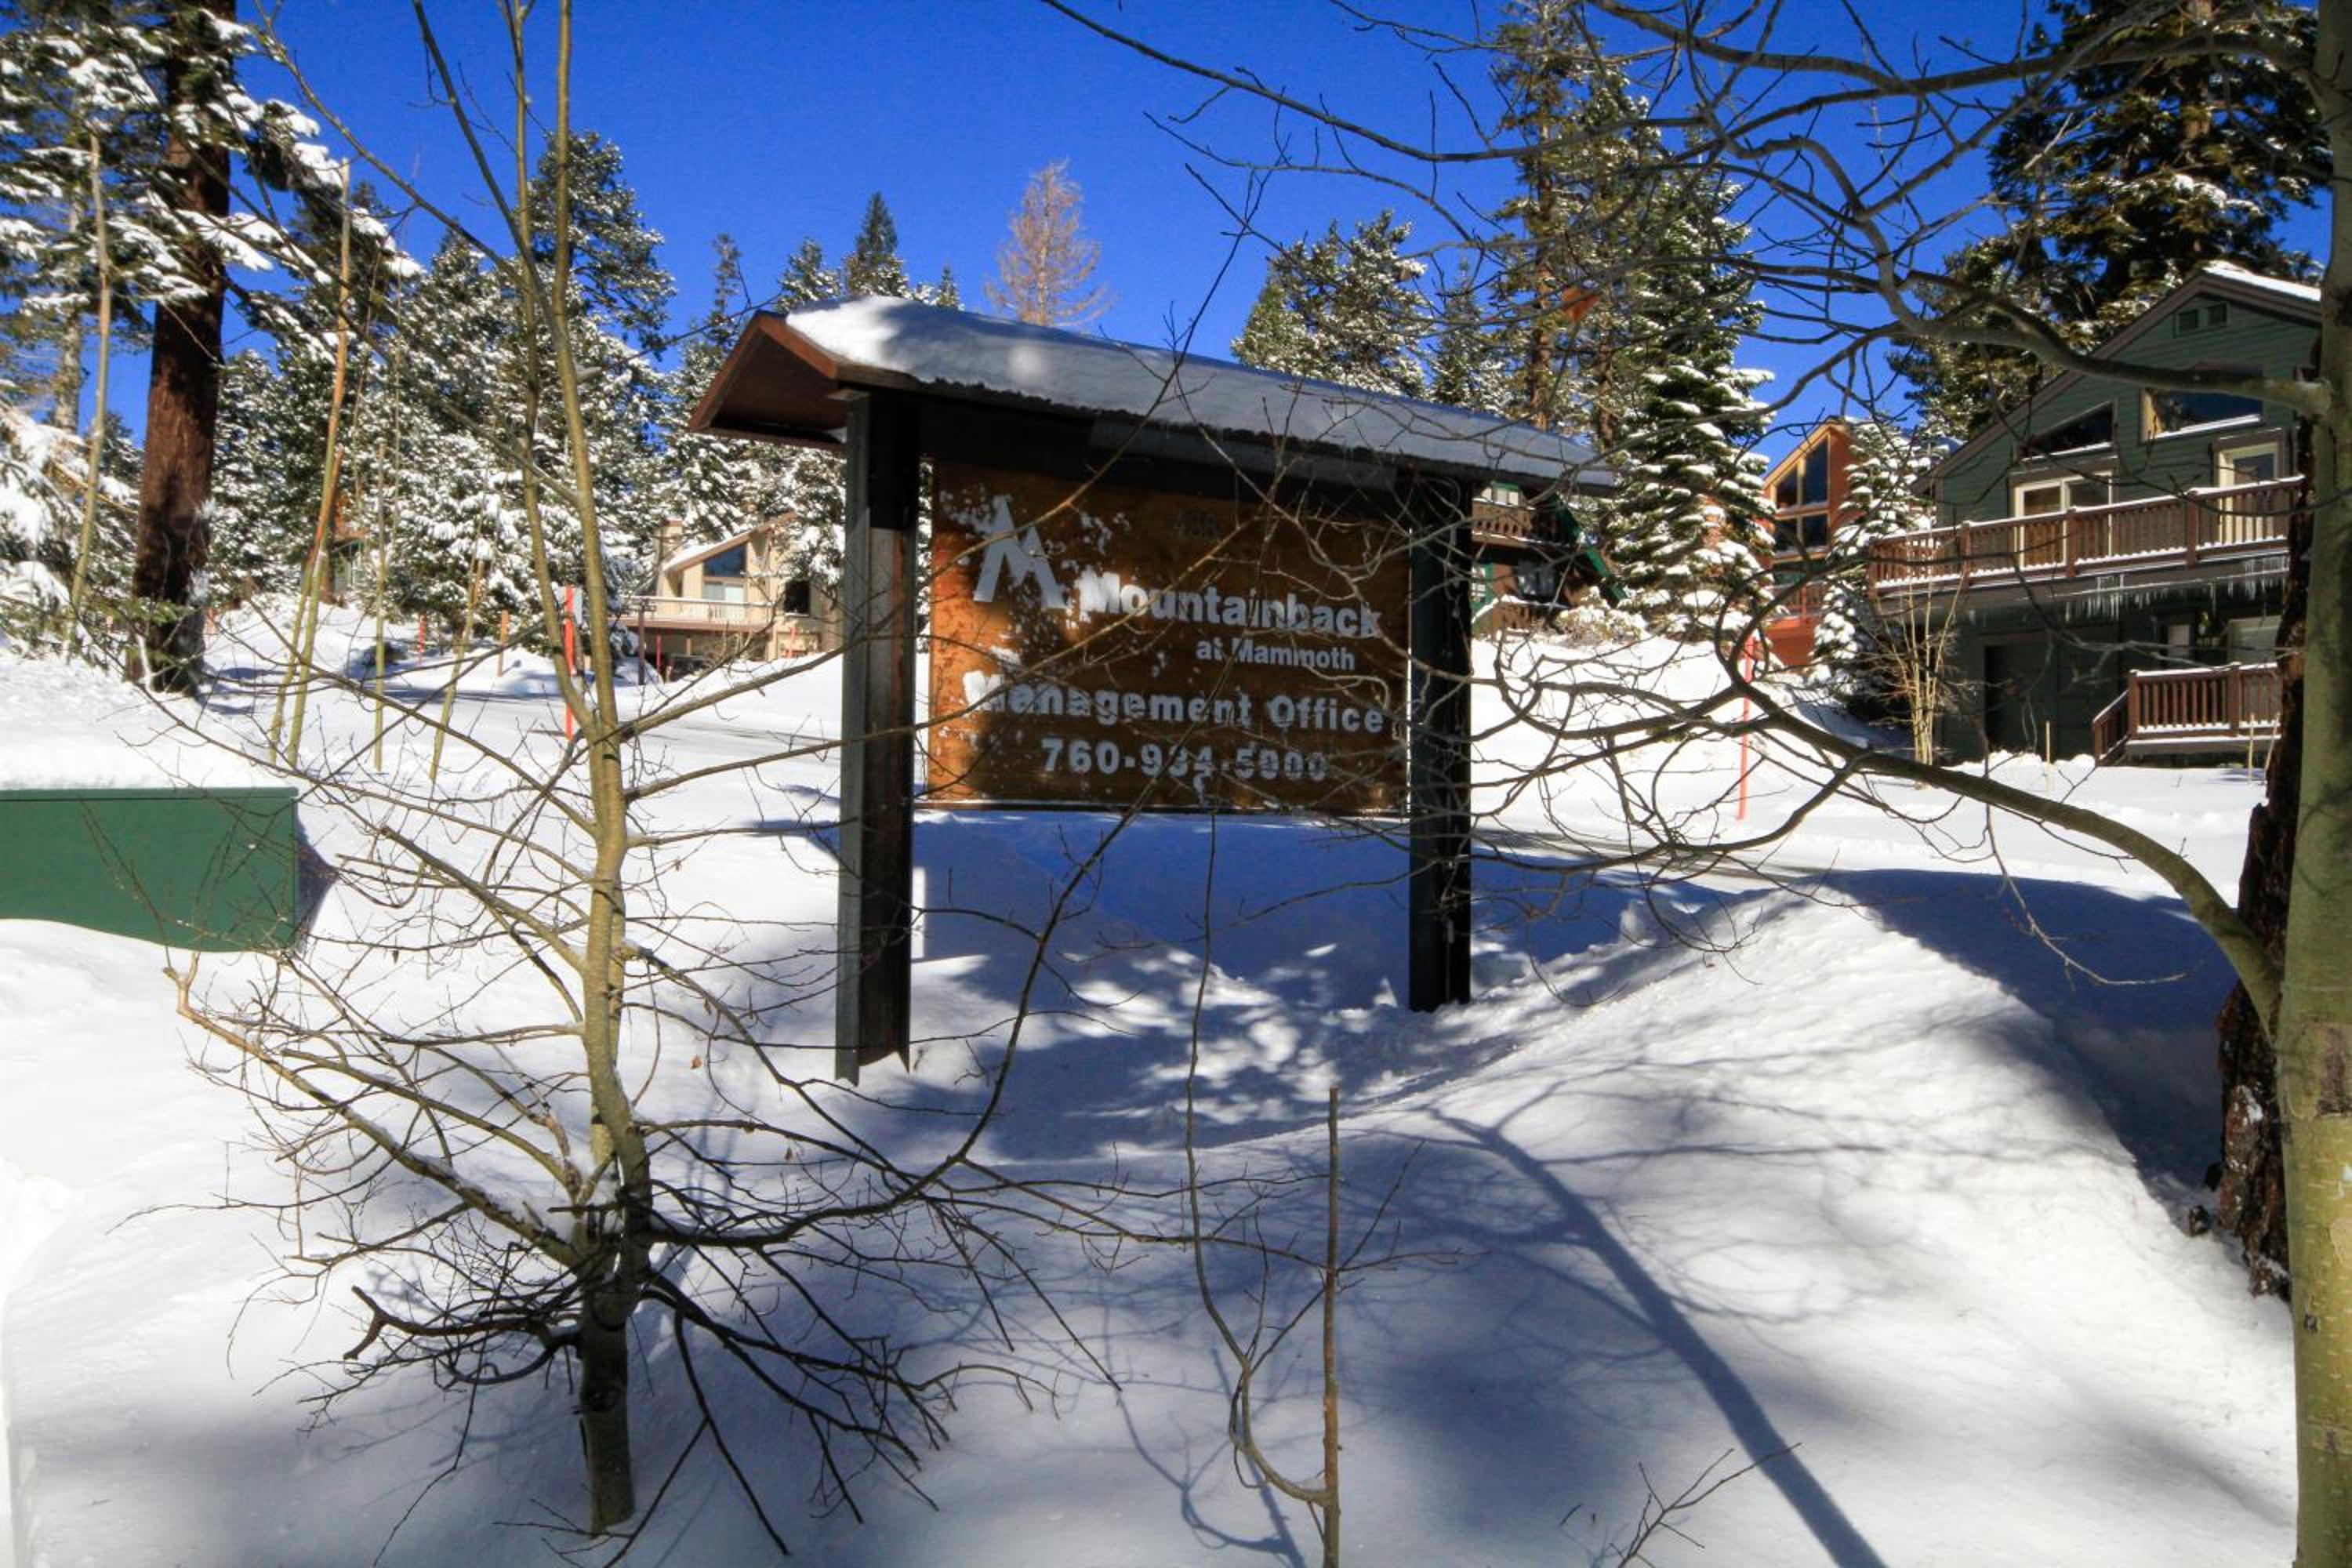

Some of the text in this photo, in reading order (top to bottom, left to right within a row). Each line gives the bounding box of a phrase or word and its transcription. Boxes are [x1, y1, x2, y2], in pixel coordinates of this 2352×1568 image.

[1079, 571, 1381, 638] Mountainback
[1196, 637, 1356, 670] at Mammoth
[963, 670, 1385, 732] Management Office
